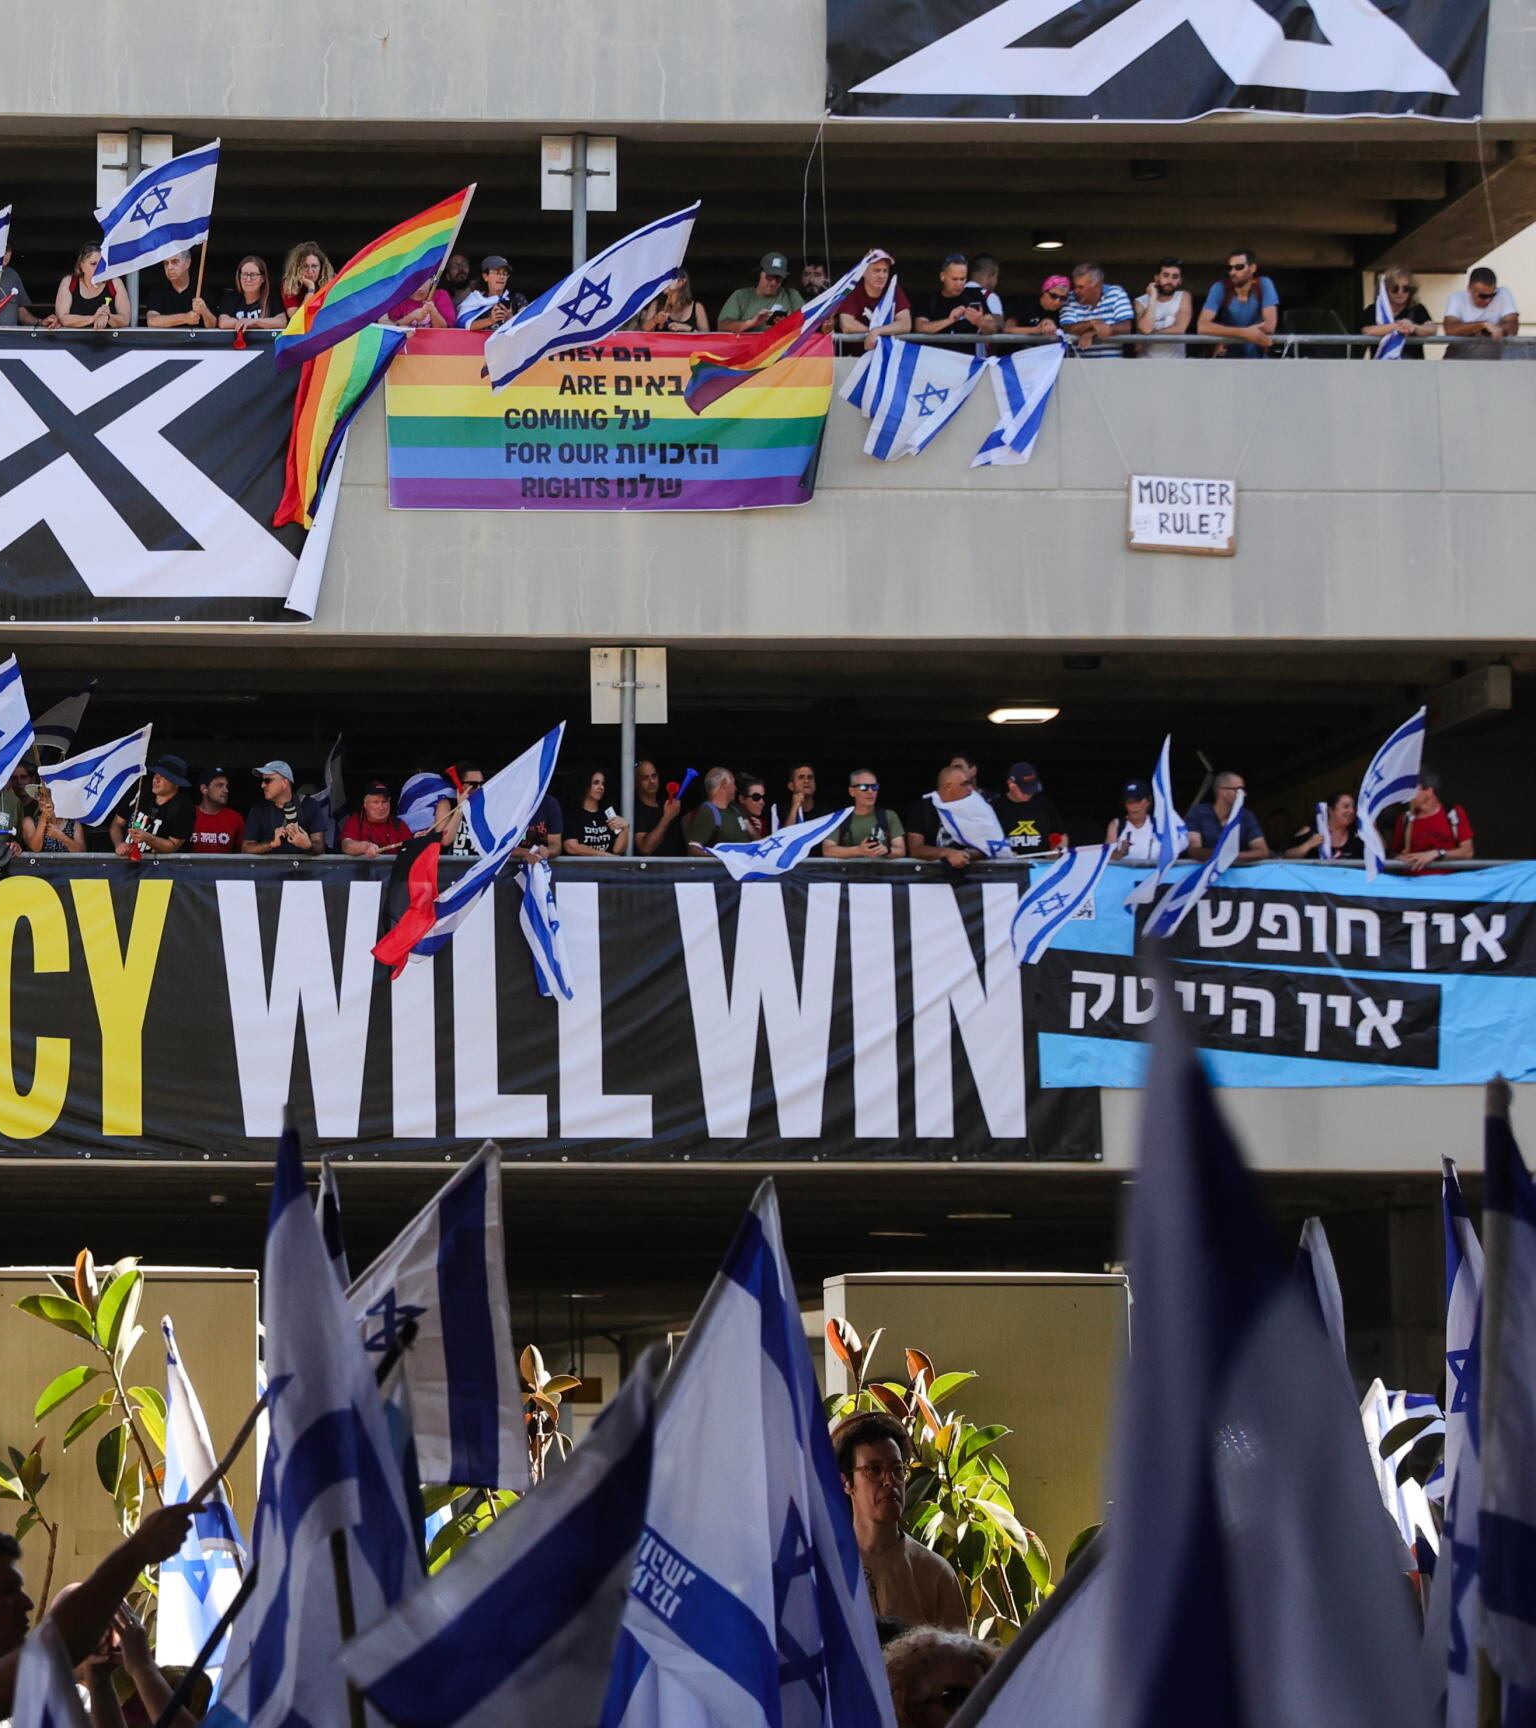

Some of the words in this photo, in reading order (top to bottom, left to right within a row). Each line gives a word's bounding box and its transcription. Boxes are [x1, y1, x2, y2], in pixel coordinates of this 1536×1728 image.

[612, 346, 652, 362] הם
[559, 374, 607, 395] ARE
[614, 375, 685, 396] באים
[504, 408, 609, 430] COMING
[614, 405, 651, 431] על
[505, 443, 552, 464] FOR
[558, 443, 609, 464] OUR
[615, 443, 719, 465] הזכויות
[521, 477, 610, 499] RIGHTS
[617, 474, 683, 499] שלנו
[1138, 481, 1233, 506] MOBSTER
[1158, 512, 1226, 534] RULE?
[1197, 898, 1381, 957] חופש
[1402, 913, 1508, 971] אין
[215, 879, 654, 1139] WILL
[675, 881, 1027, 1139] WIN
[1298, 990, 1404, 1053] אין
